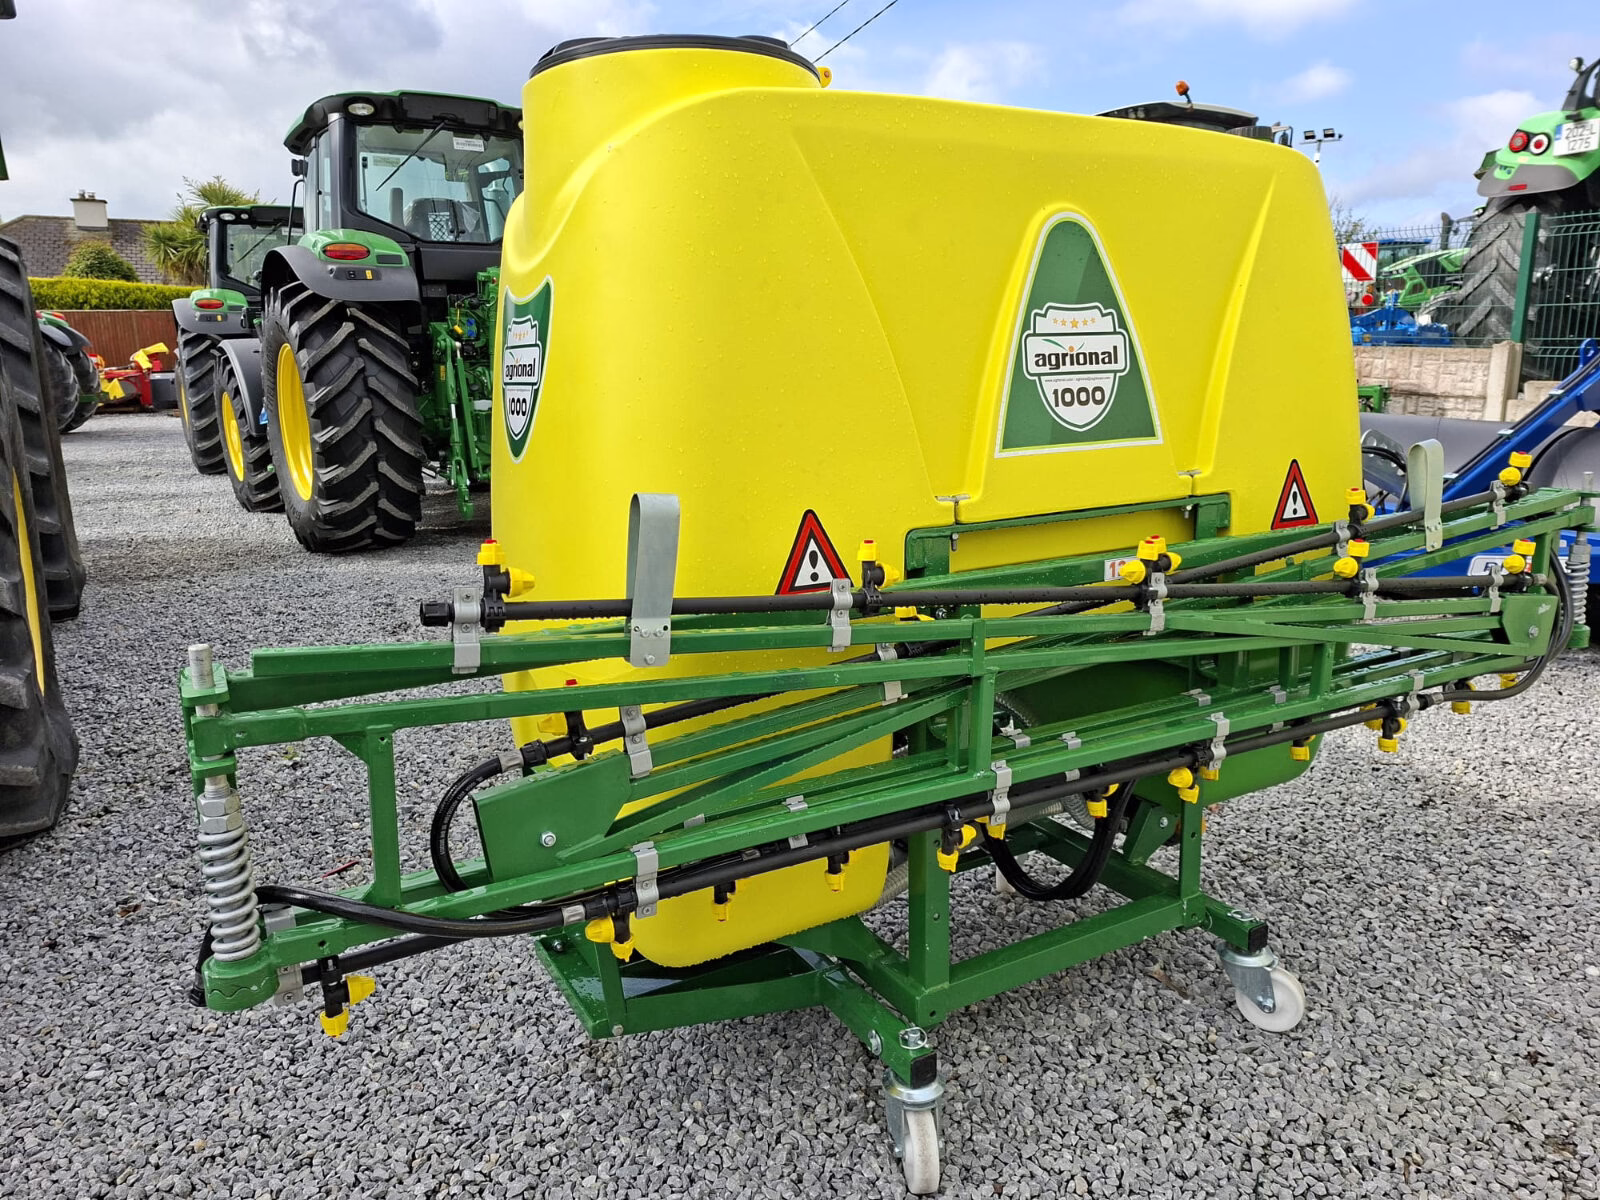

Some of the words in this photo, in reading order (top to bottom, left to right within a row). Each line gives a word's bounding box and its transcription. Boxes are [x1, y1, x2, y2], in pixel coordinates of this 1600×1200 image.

[505, 357, 536, 381] agrional
[1034, 345, 1119, 371] agrional
[508, 397, 528, 417] 1000
[1052, 385, 1106, 408] 1000
